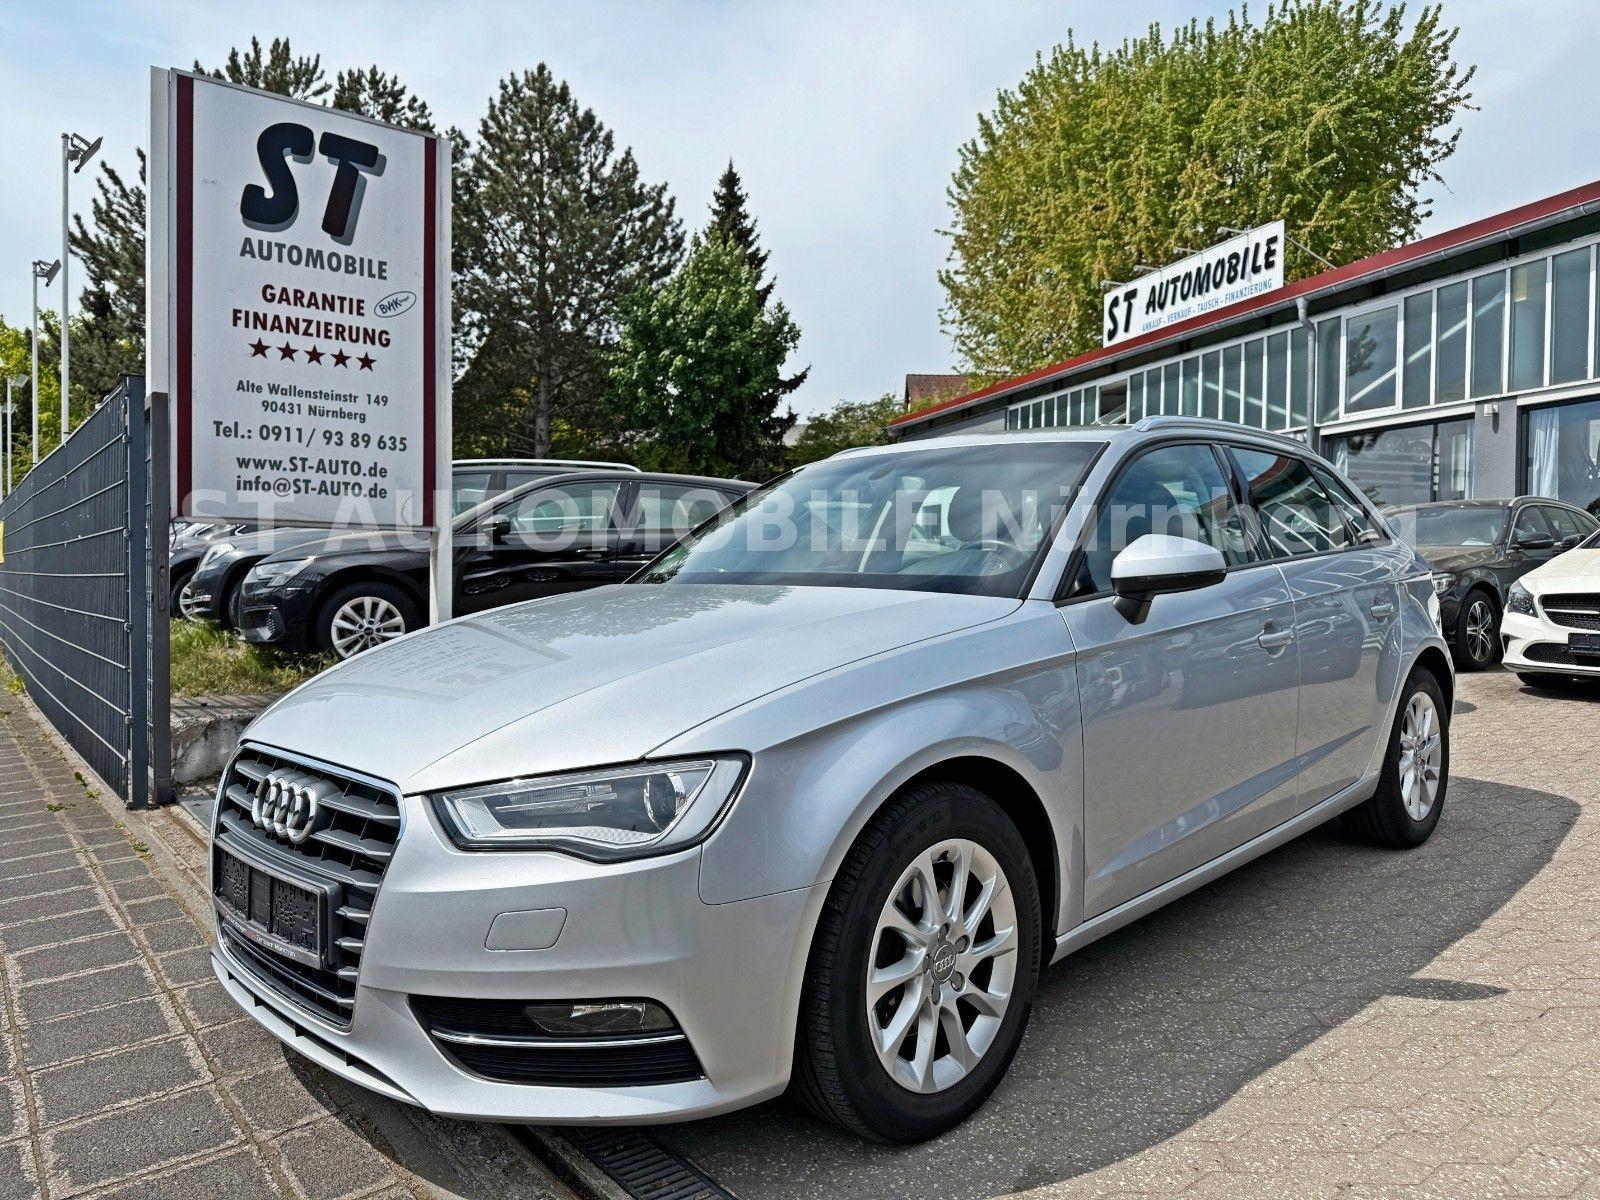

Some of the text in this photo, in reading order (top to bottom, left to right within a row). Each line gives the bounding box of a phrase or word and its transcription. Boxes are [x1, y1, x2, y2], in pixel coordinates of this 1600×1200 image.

[240, 122, 387, 247] ST
[239, 236, 388, 281] AUTOMOBILE
[262, 283, 365, 318] GARANTIE
[1107, 235, 1279, 341] ST AUTOMOBILE
[1167, 307, 1192, 324] VERKAUF
[1197, 297, 1219, 312] TAUSCH
[1224, 278, 1273, 304] FINANZIERUNG
[232, 308, 391, 348] FINANZIERUNG
[236, 379, 389, 407] Alte Wallensteinstr 149
[261, 399, 367, 424] 90431 Nürnberg
[213, 420, 252, 440] Tel.:
[322, 429, 344, 447] 93
[350, 431, 372, 449] 89
[377, 434, 408, 453] 635
[236, 455, 388, 479] www.ST-AUTO.de
[236, 474, 388, 500] info@ST-AUTO.de
